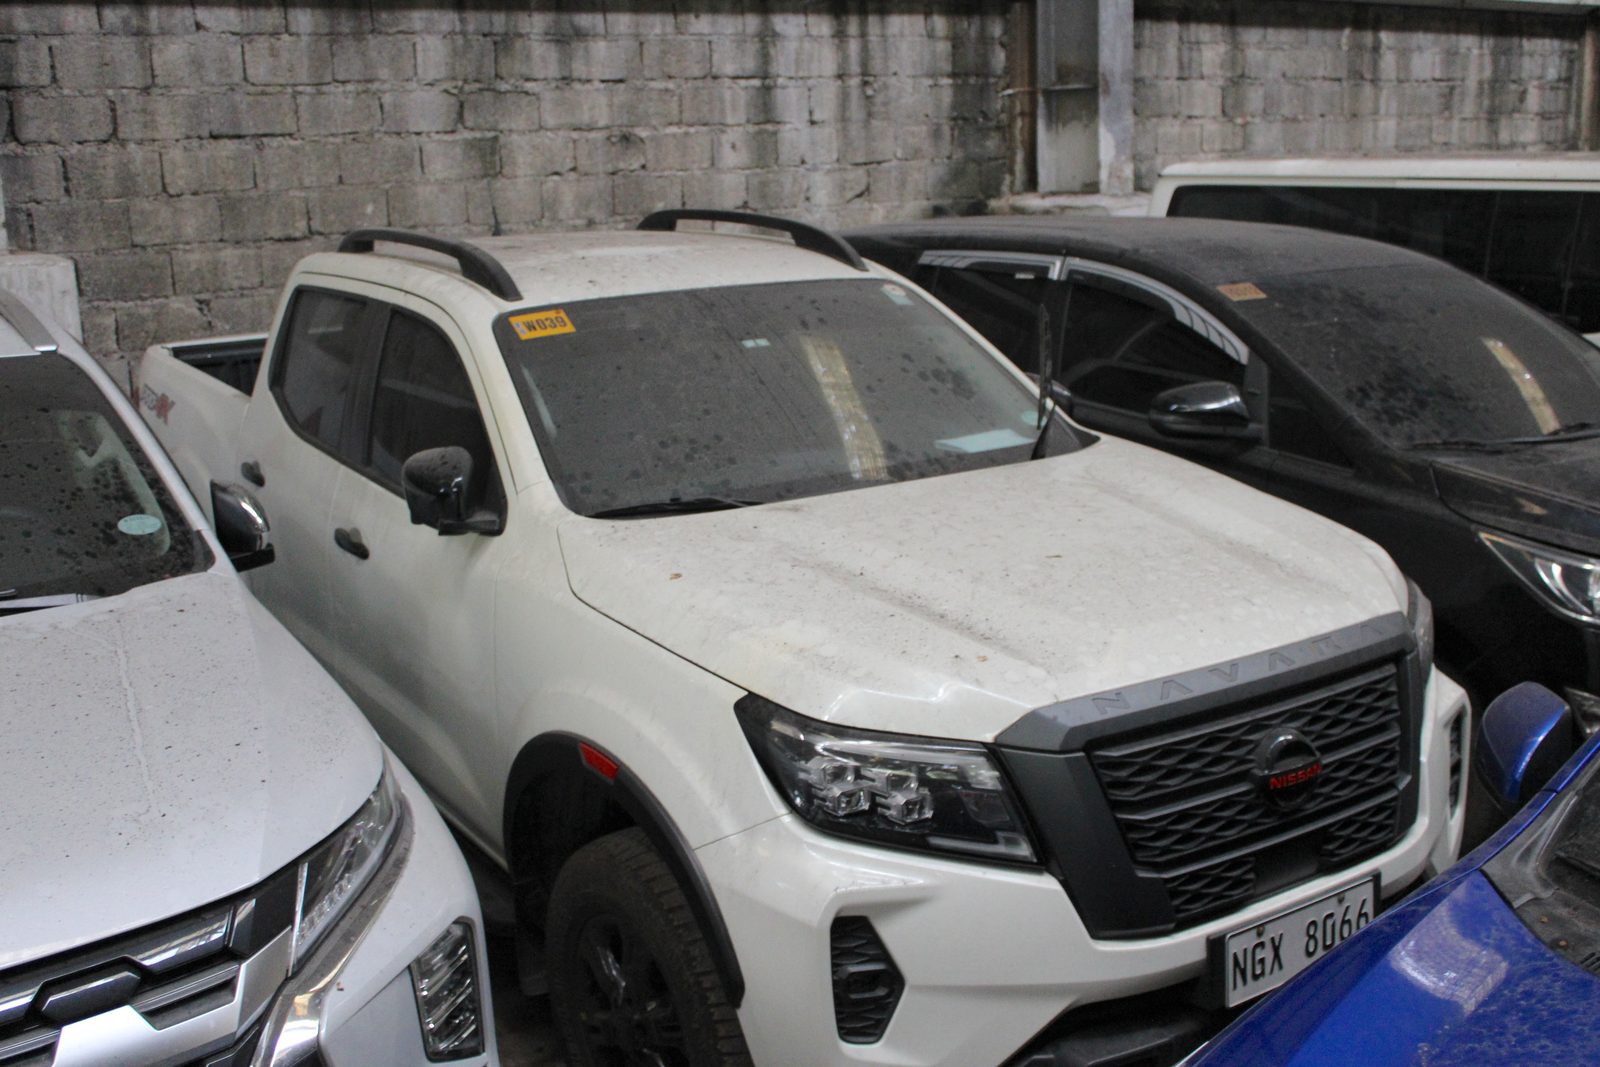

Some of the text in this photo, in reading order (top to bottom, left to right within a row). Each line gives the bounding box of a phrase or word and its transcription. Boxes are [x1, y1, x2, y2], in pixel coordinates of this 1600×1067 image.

[524, 316, 567, 332] W039
[1092, 624, 1382, 715] NAVARA
[1270, 762, 1322, 789] NISSAN
[1232, 898, 1369, 991] NGX 8066
